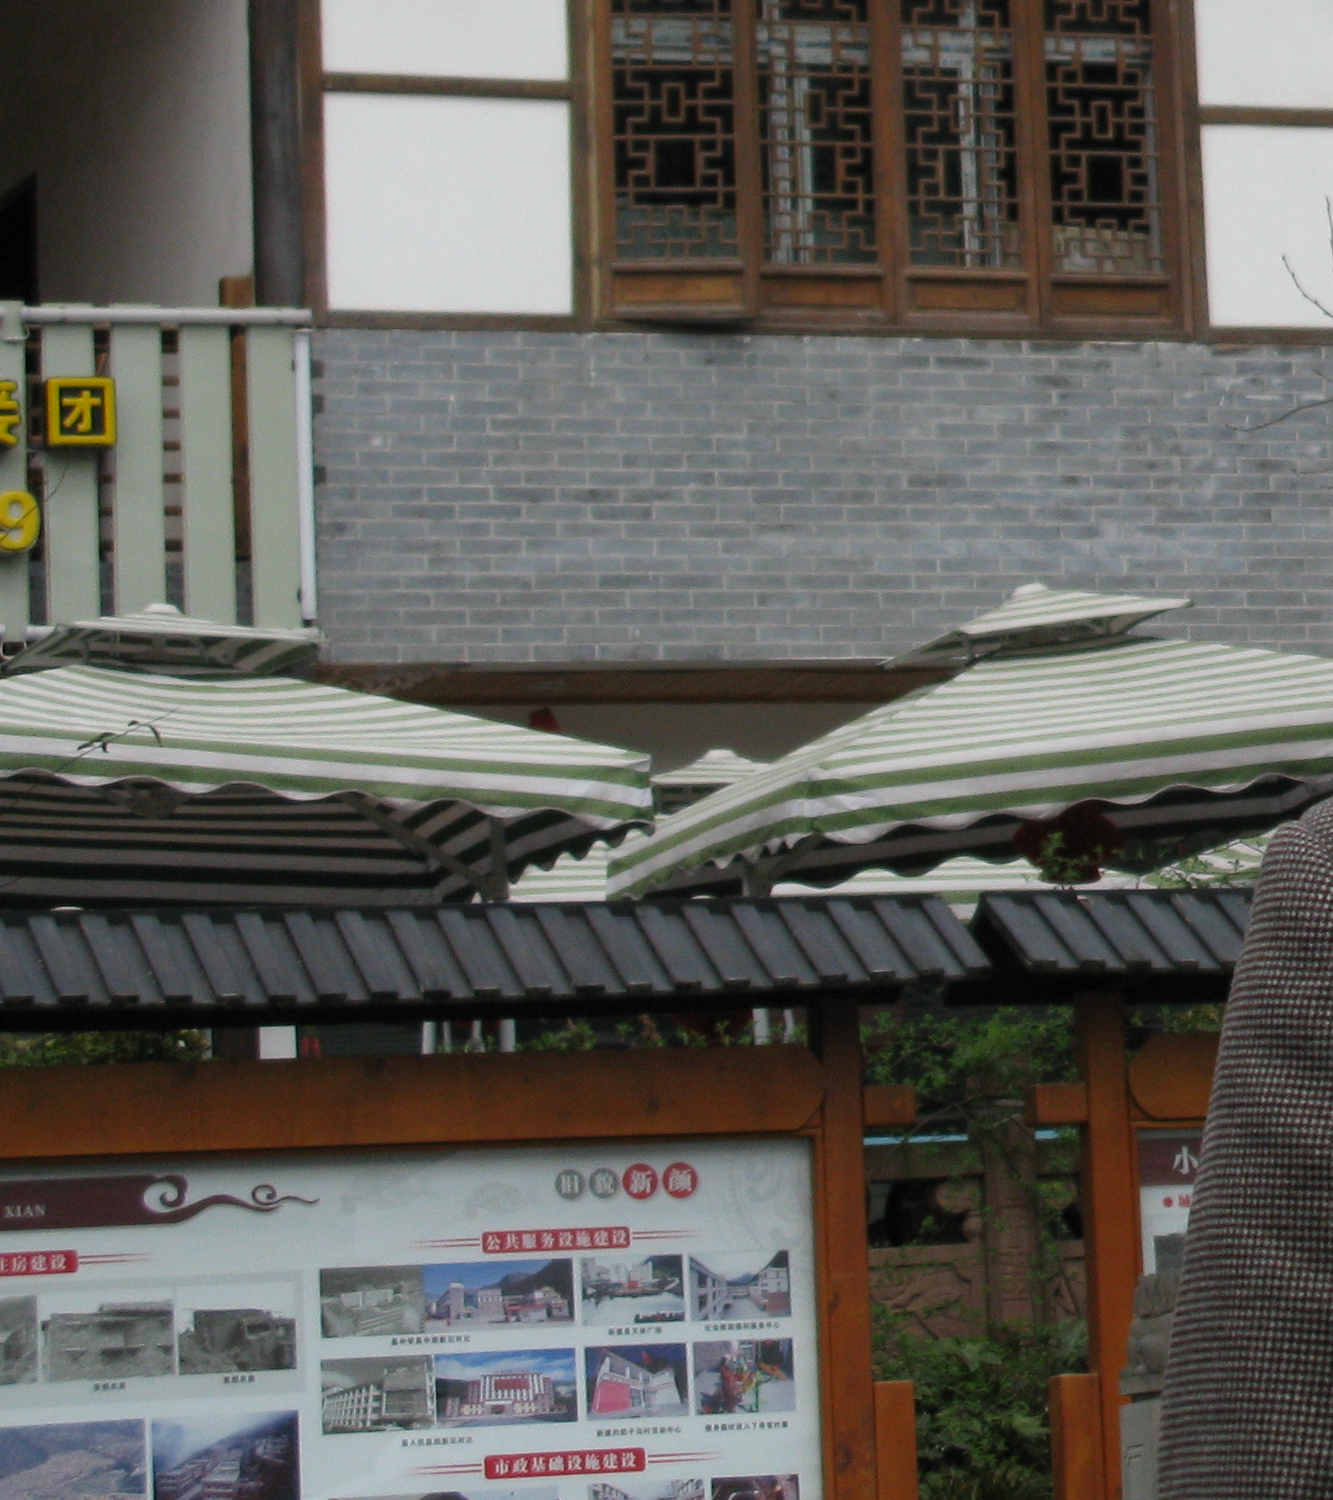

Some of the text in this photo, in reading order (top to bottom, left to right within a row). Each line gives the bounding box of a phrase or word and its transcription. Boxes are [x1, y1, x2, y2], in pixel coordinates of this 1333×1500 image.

[1172, 1146, 1199, 1175] 小
[4, 1203, 48, 1218] XIAN
[485, 1228, 628, 1251] 公共服务设施建设
[494, 1451, 637, 1476] 市政基础设施建设
